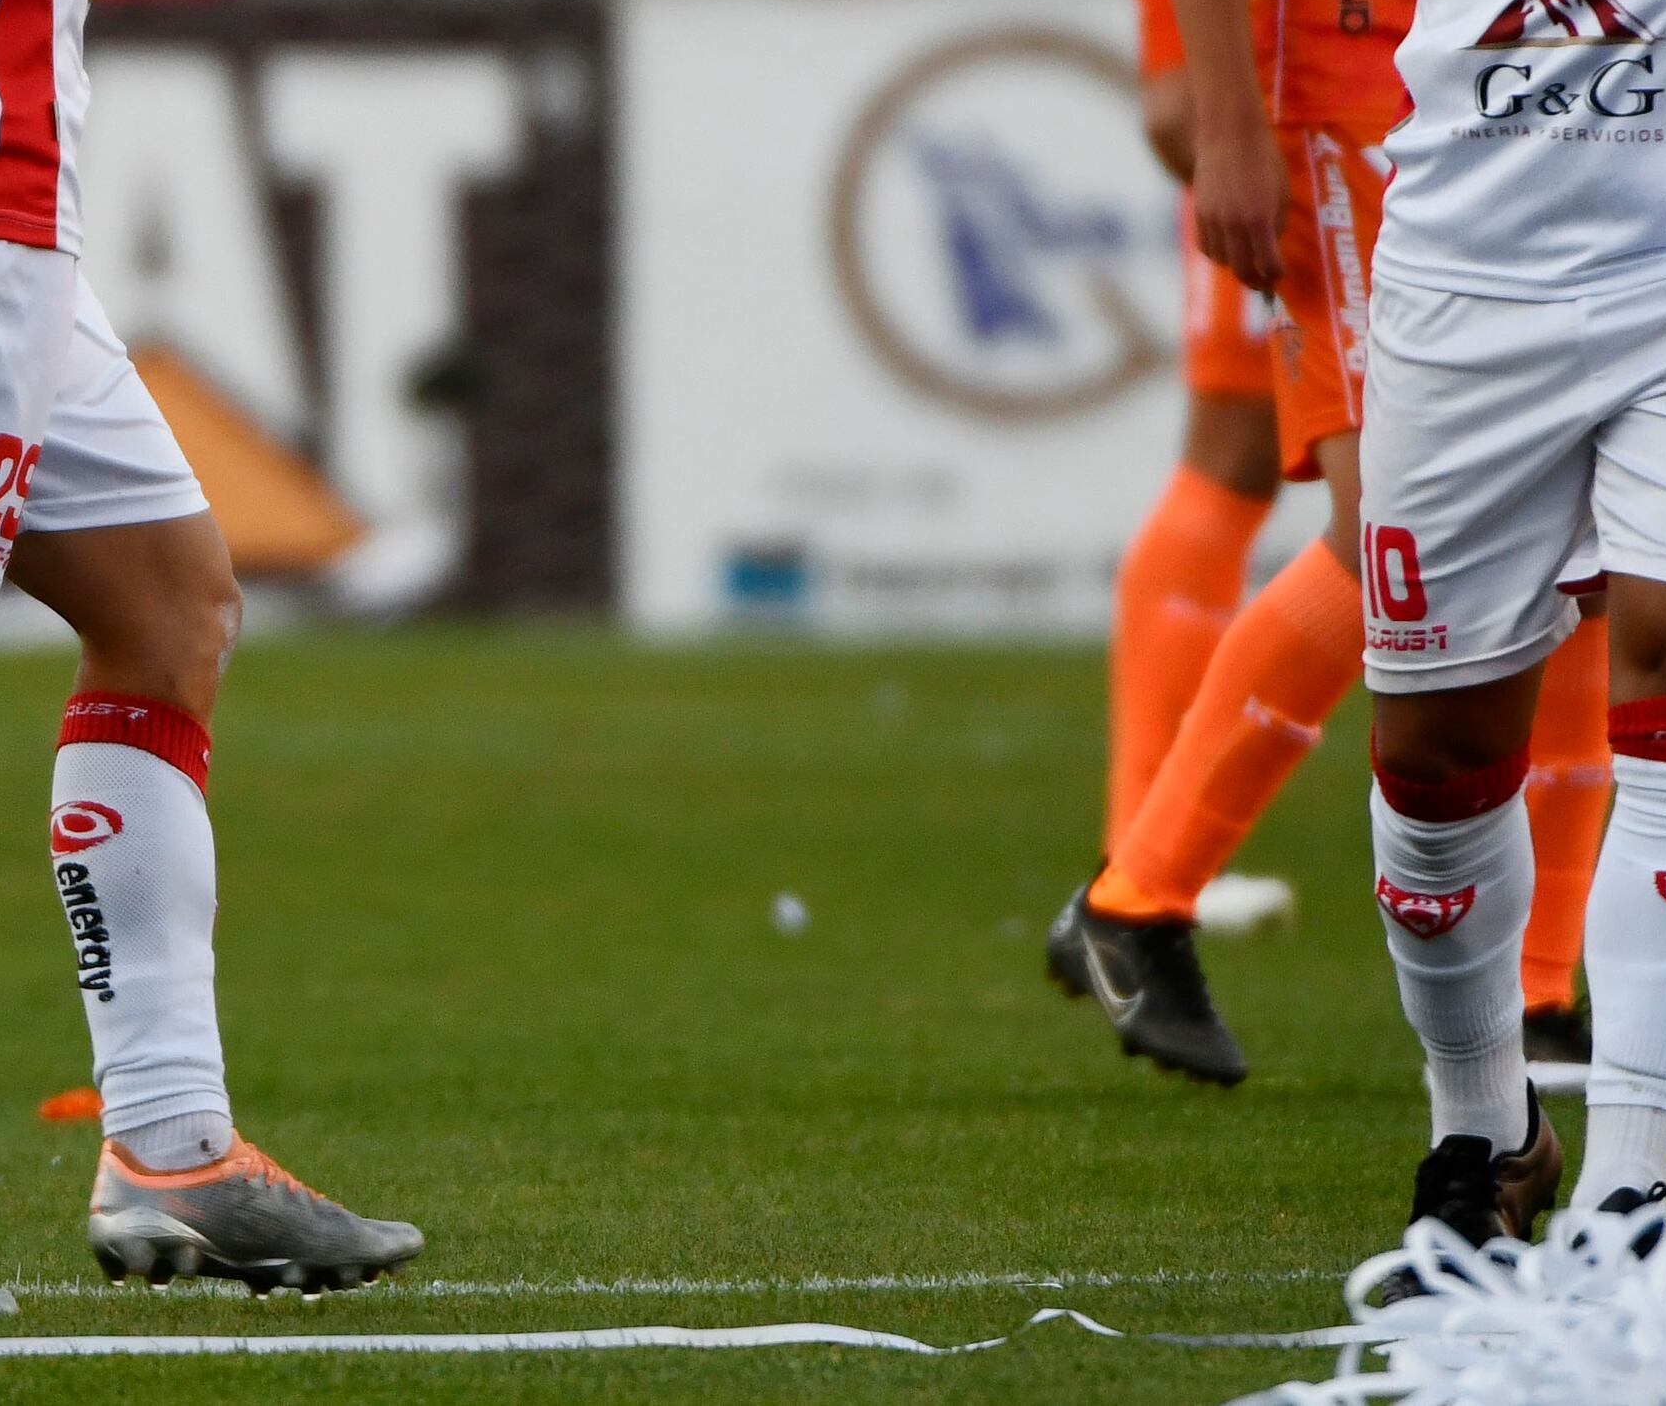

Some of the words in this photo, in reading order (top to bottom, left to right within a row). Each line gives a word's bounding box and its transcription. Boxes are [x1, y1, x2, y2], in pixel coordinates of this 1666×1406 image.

[1550, 126, 1666, 142] SERVICIOS
[1365, 520, 1429, 622] 10
[56, 862, 113, 991] energy
